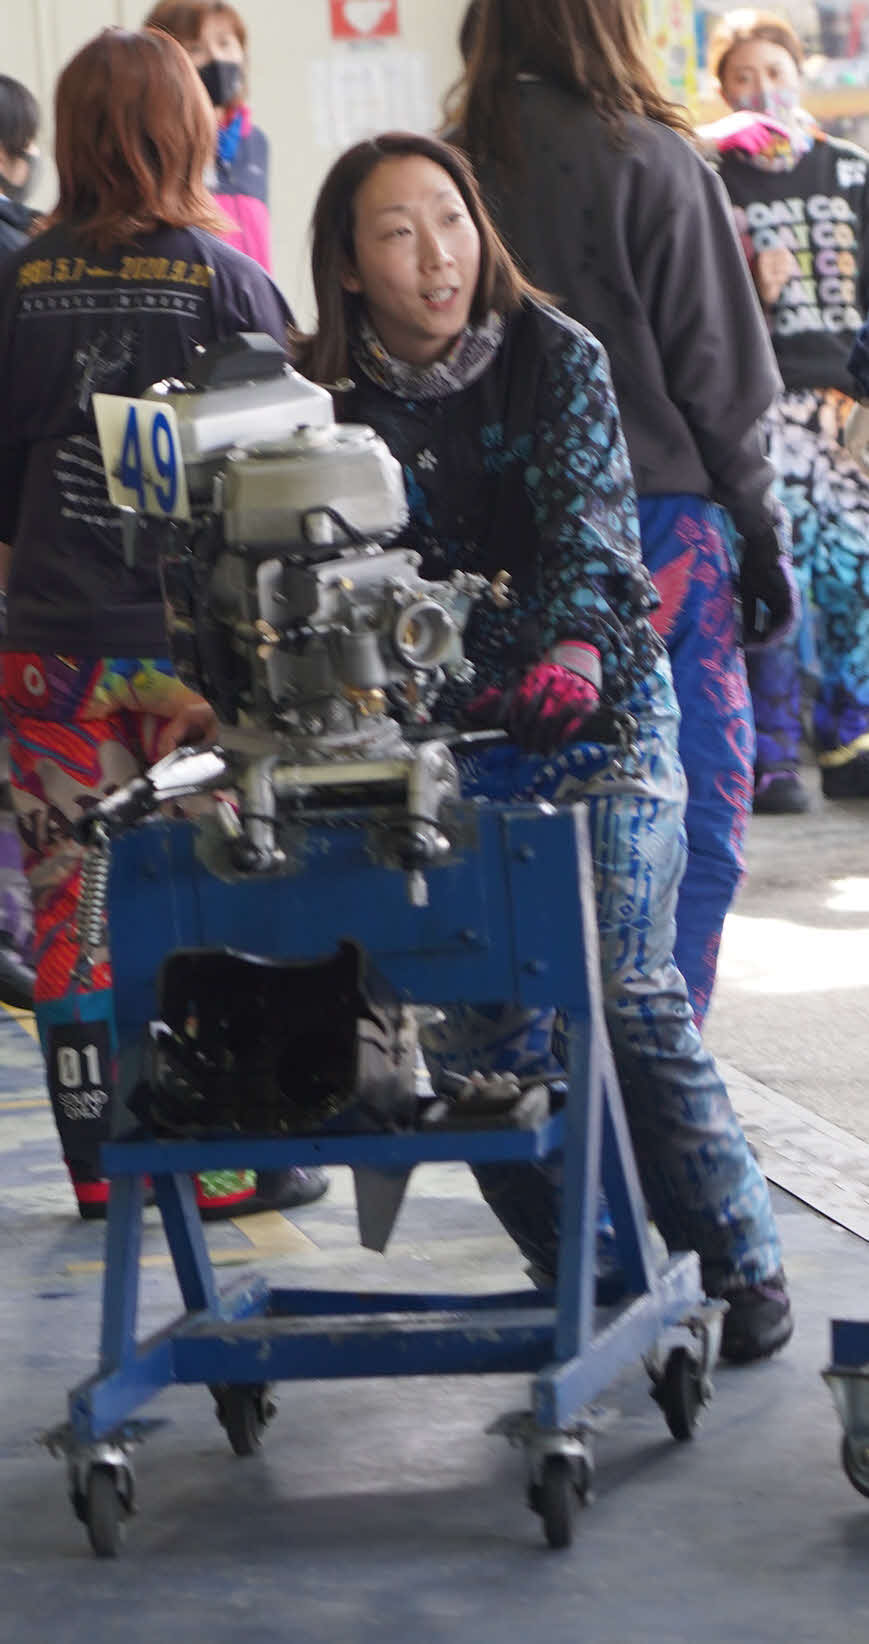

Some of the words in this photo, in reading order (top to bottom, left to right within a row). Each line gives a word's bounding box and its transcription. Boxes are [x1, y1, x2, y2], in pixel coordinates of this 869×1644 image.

[743, 198, 807, 228] OAT
[120, 404, 178, 514] 49
[57, 1044, 102, 1088] 01
